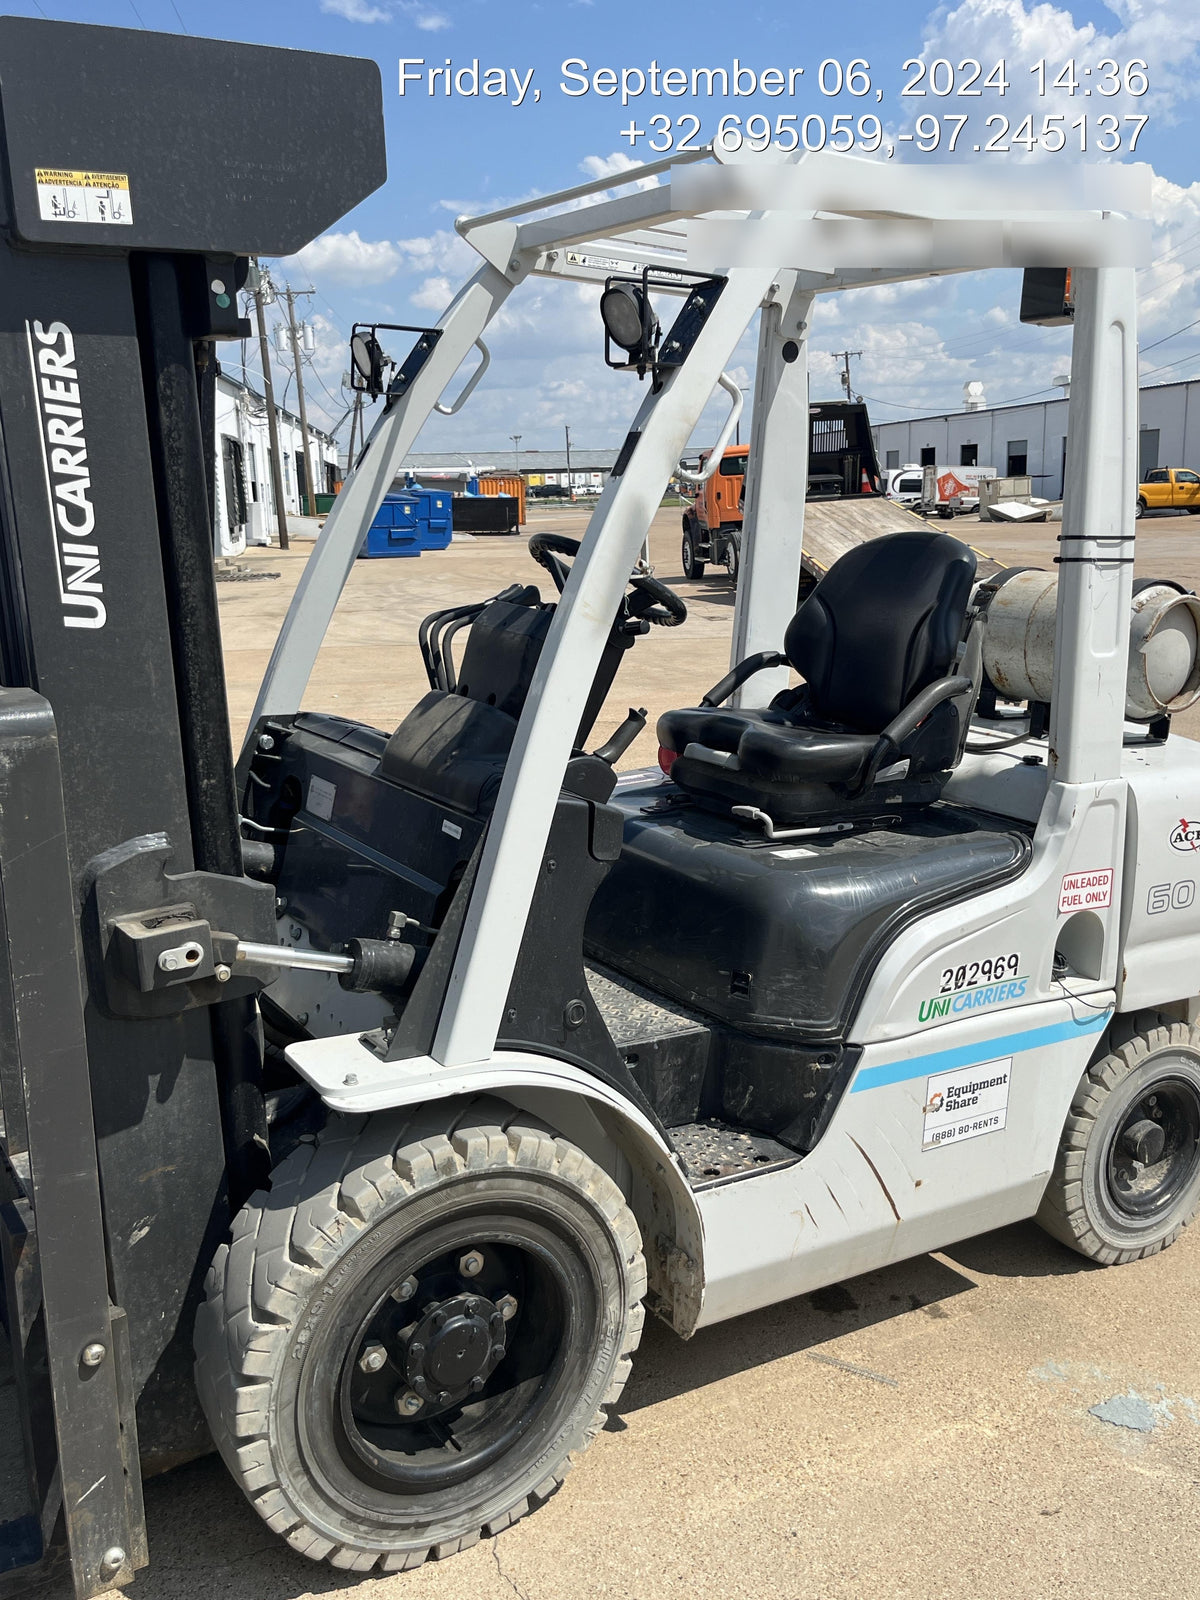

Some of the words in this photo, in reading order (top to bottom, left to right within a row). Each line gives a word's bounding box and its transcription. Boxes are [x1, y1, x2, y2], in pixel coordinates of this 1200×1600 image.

[43, 171, 73, 179] WARNING
[1063, 874, 1109, 891] UNLEADED
[1061, 894, 1083, 907] FUEL
[1085, 890, 1108, 904] ONLY
[1146, 879, 1196, 916] 60
[940, 953, 1019, 994] 202969
[946, 1073, 1007, 1098] Equipment
[945, 1095, 978, 1112] Share
[932, 1128, 956, 1142] (888)
